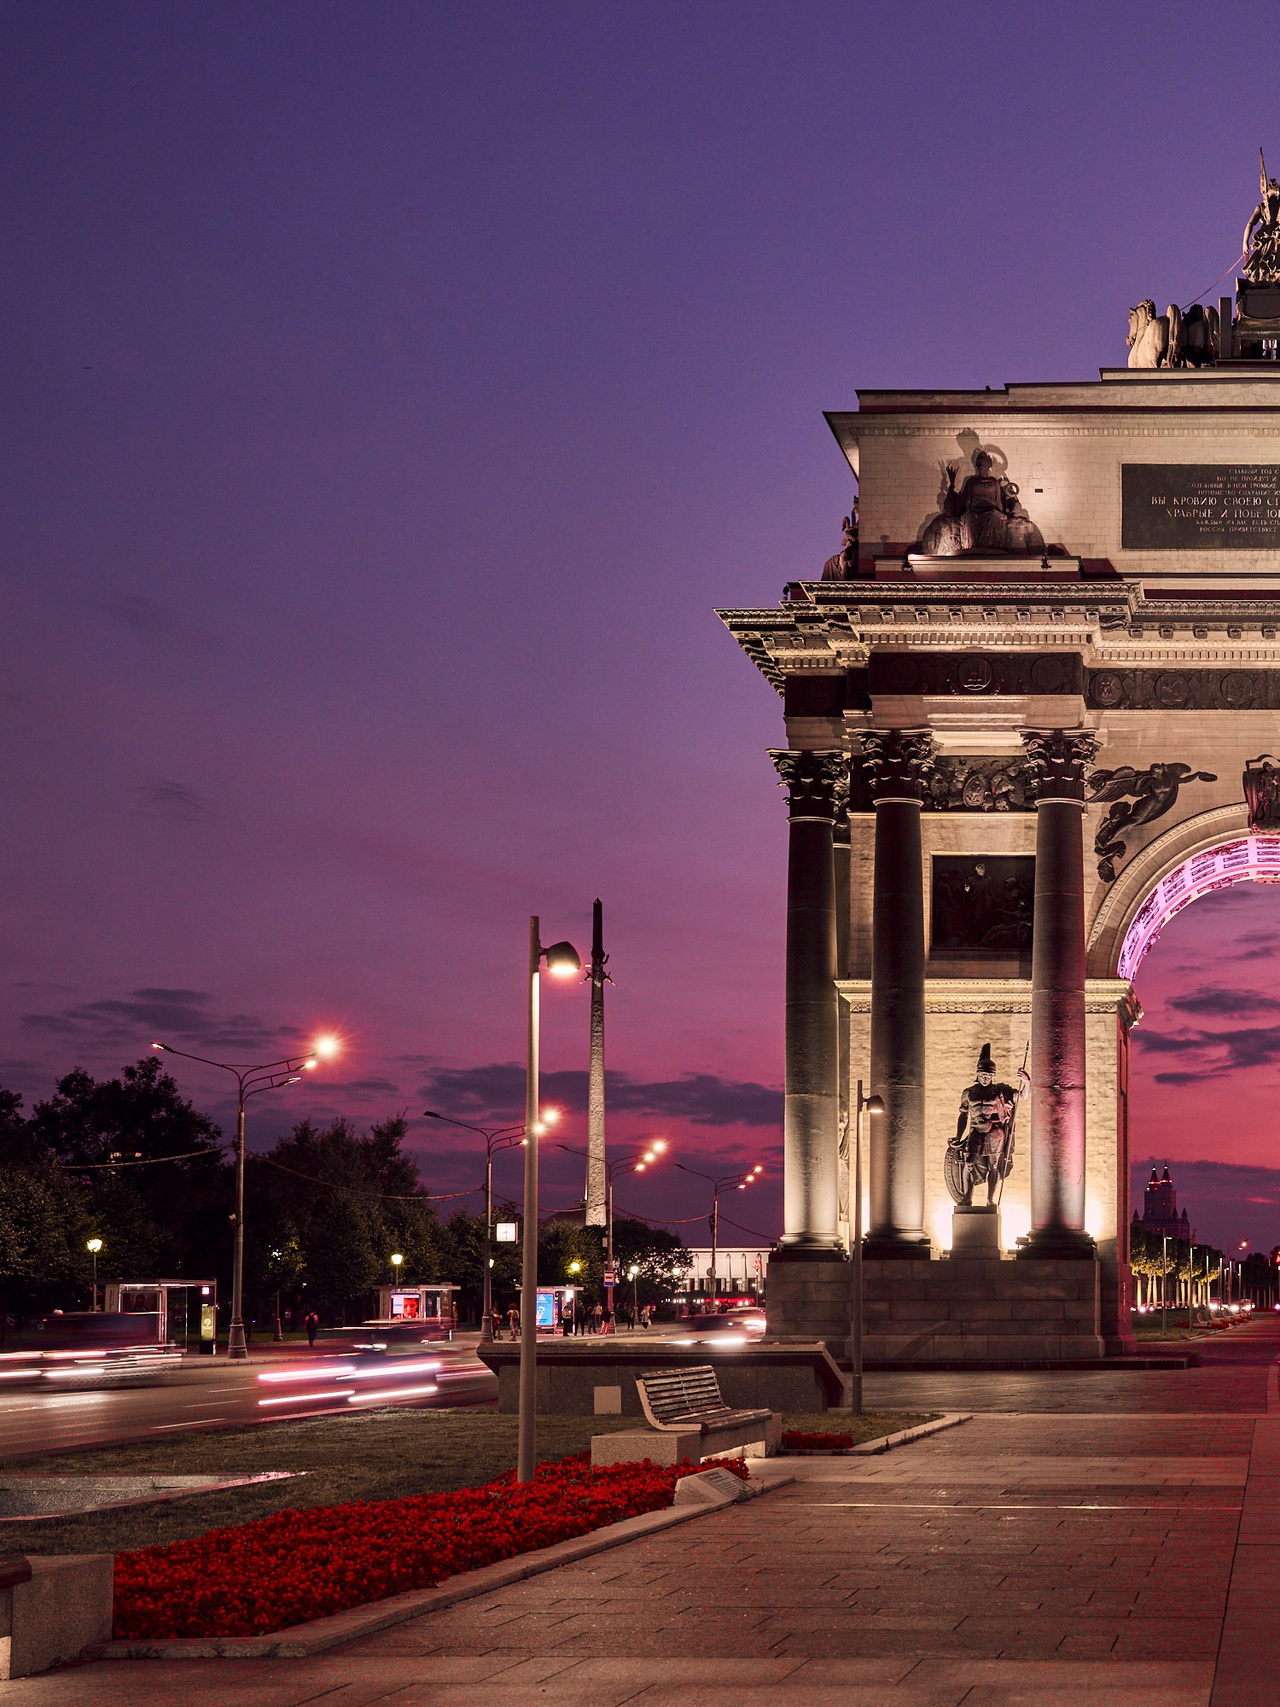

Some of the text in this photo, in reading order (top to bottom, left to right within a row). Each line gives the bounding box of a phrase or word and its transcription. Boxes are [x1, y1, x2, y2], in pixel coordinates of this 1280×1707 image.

[1152, 497, 1166, 506] ВЫ
[1174, 497, 1217, 506] КРОВИЮ
[1224, 497, 1262, 506] СВОЕЮ
[1166, 508, 1215, 518] ХРАБРЫЕ
[1221, 508, 1229, 518] И
